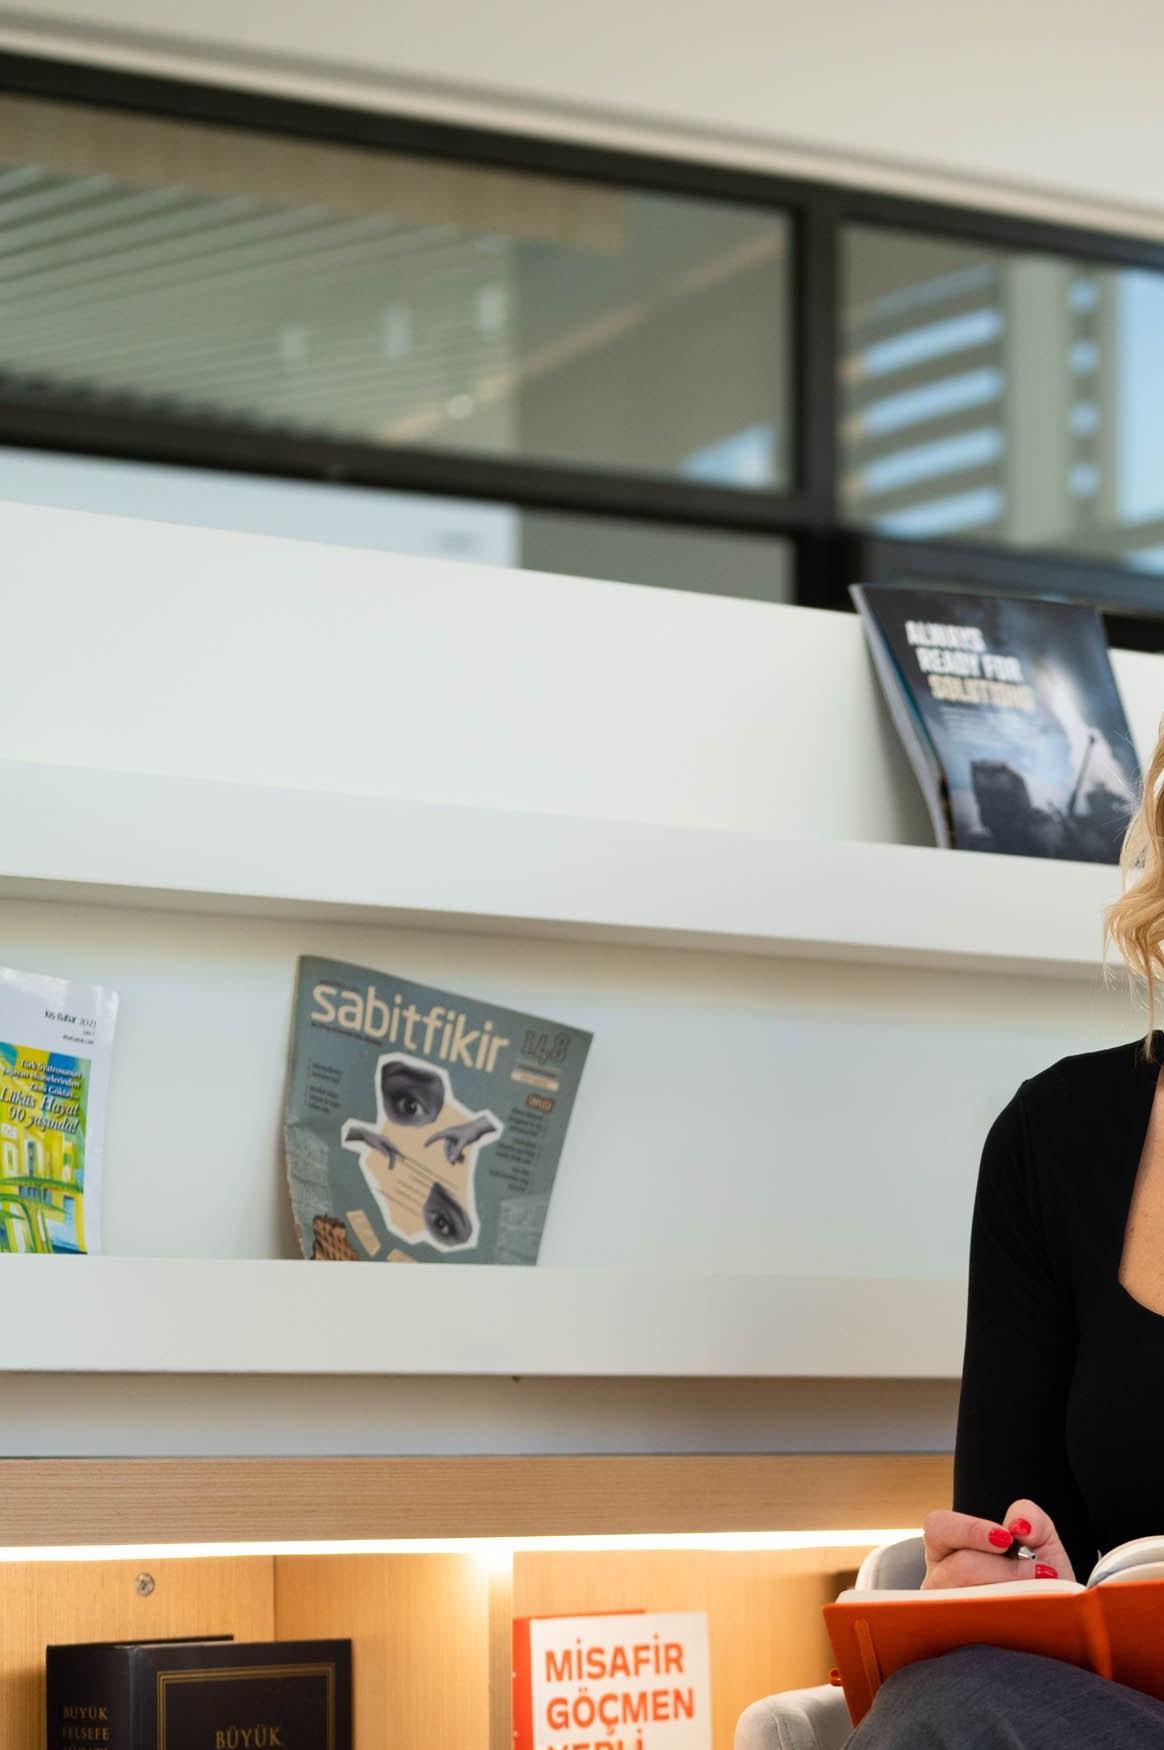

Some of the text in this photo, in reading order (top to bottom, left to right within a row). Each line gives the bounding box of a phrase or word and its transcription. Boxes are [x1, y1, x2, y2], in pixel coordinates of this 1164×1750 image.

[905, 620, 986, 652] ALWAYS
[915, 647, 1025, 682] READY FOR
[311, 984, 511, 1073] sabitfikir
[521, 1029, 571, 1064] 148
[9, 1106, 26, 1122] 90
[40, 1095, 80, 1119] Hayat
[545, 1633, 684, 1683] MİSAFİR
[545, 1686, 695, 1737] GÖÇMEN
[61, 1727, 109, 1741] FELSEFE
[215, 1724, 282, 1750] BÜYÜK
